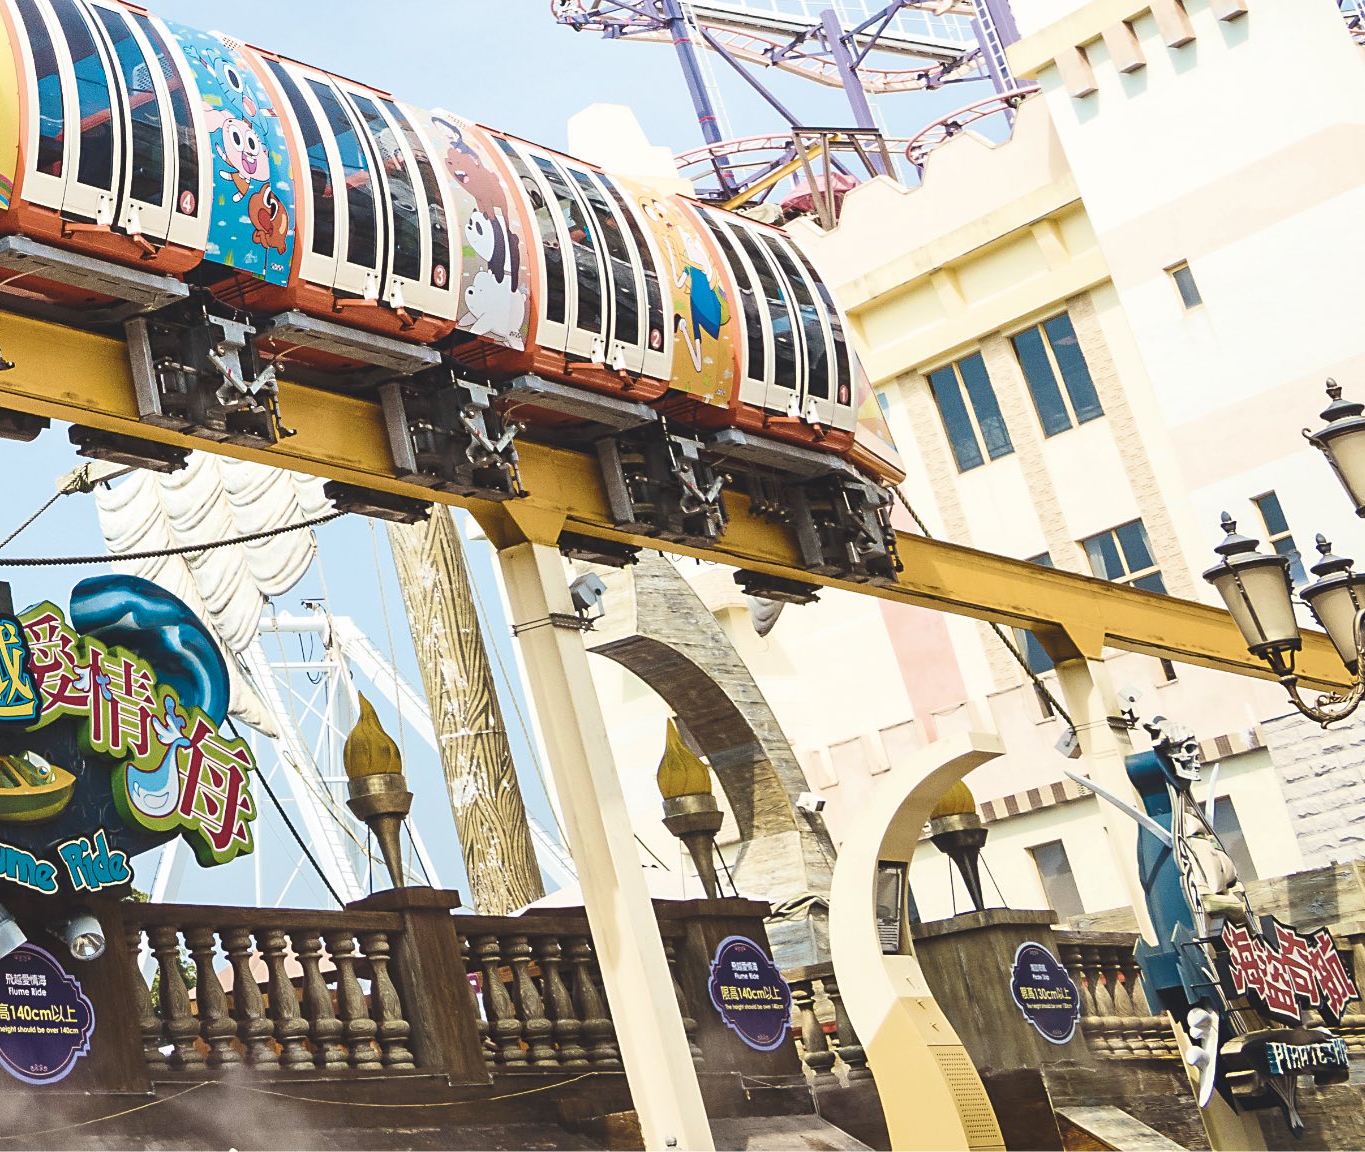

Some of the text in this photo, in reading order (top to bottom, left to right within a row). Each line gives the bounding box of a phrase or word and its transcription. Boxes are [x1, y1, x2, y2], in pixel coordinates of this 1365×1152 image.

[183, 195, 193, 212] 4
[436, 268, 445, 284] 3
[652, 331, 660, 347] 2
[58, 829, 133, 893] Ride
[8, 987, 47, 997] Flume Ride
[17, 1025, 36, 1033] should
